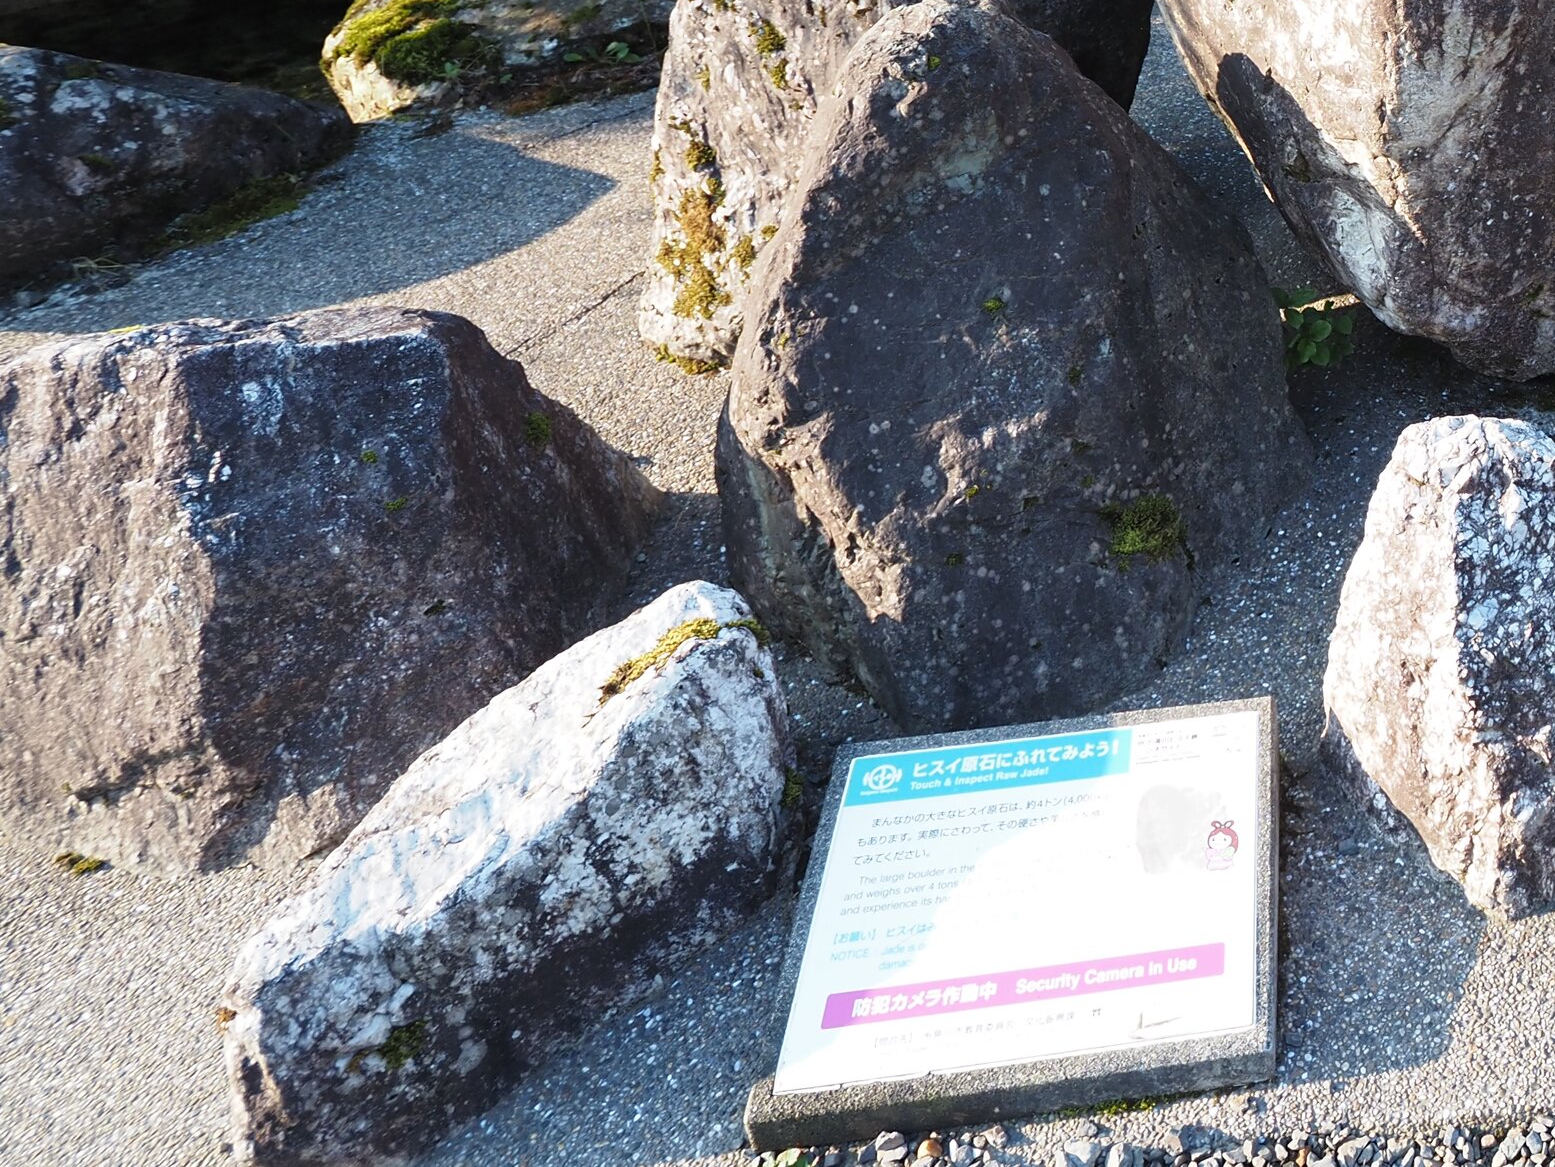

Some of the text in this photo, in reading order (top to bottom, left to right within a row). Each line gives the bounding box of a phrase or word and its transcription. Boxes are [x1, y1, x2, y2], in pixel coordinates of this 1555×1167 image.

[910, 766, 1049, 790] Touch & Inspect Raw Jade!
[853, 849, 931, 866] てみてください。
[858, 864, 976, 885] The large boulder in the
[843, 891, 863, 901] and
[866, 887, 901, 900] weighs
[903, 884, 926, 894] over
[928, 882, 935, 890] 4
[937, 880, 960, 890] tons
[839, 905, 860, 916] and
[862, 899, 918, 915] experience
[920, 896, 933, 907] its
[830, 947, 871, 962] NOTICE
[1015, 973, 1081, 995] Security
[1084, 965, 1145, 985] Camera
[1167, 957, 1198, 974] Use
